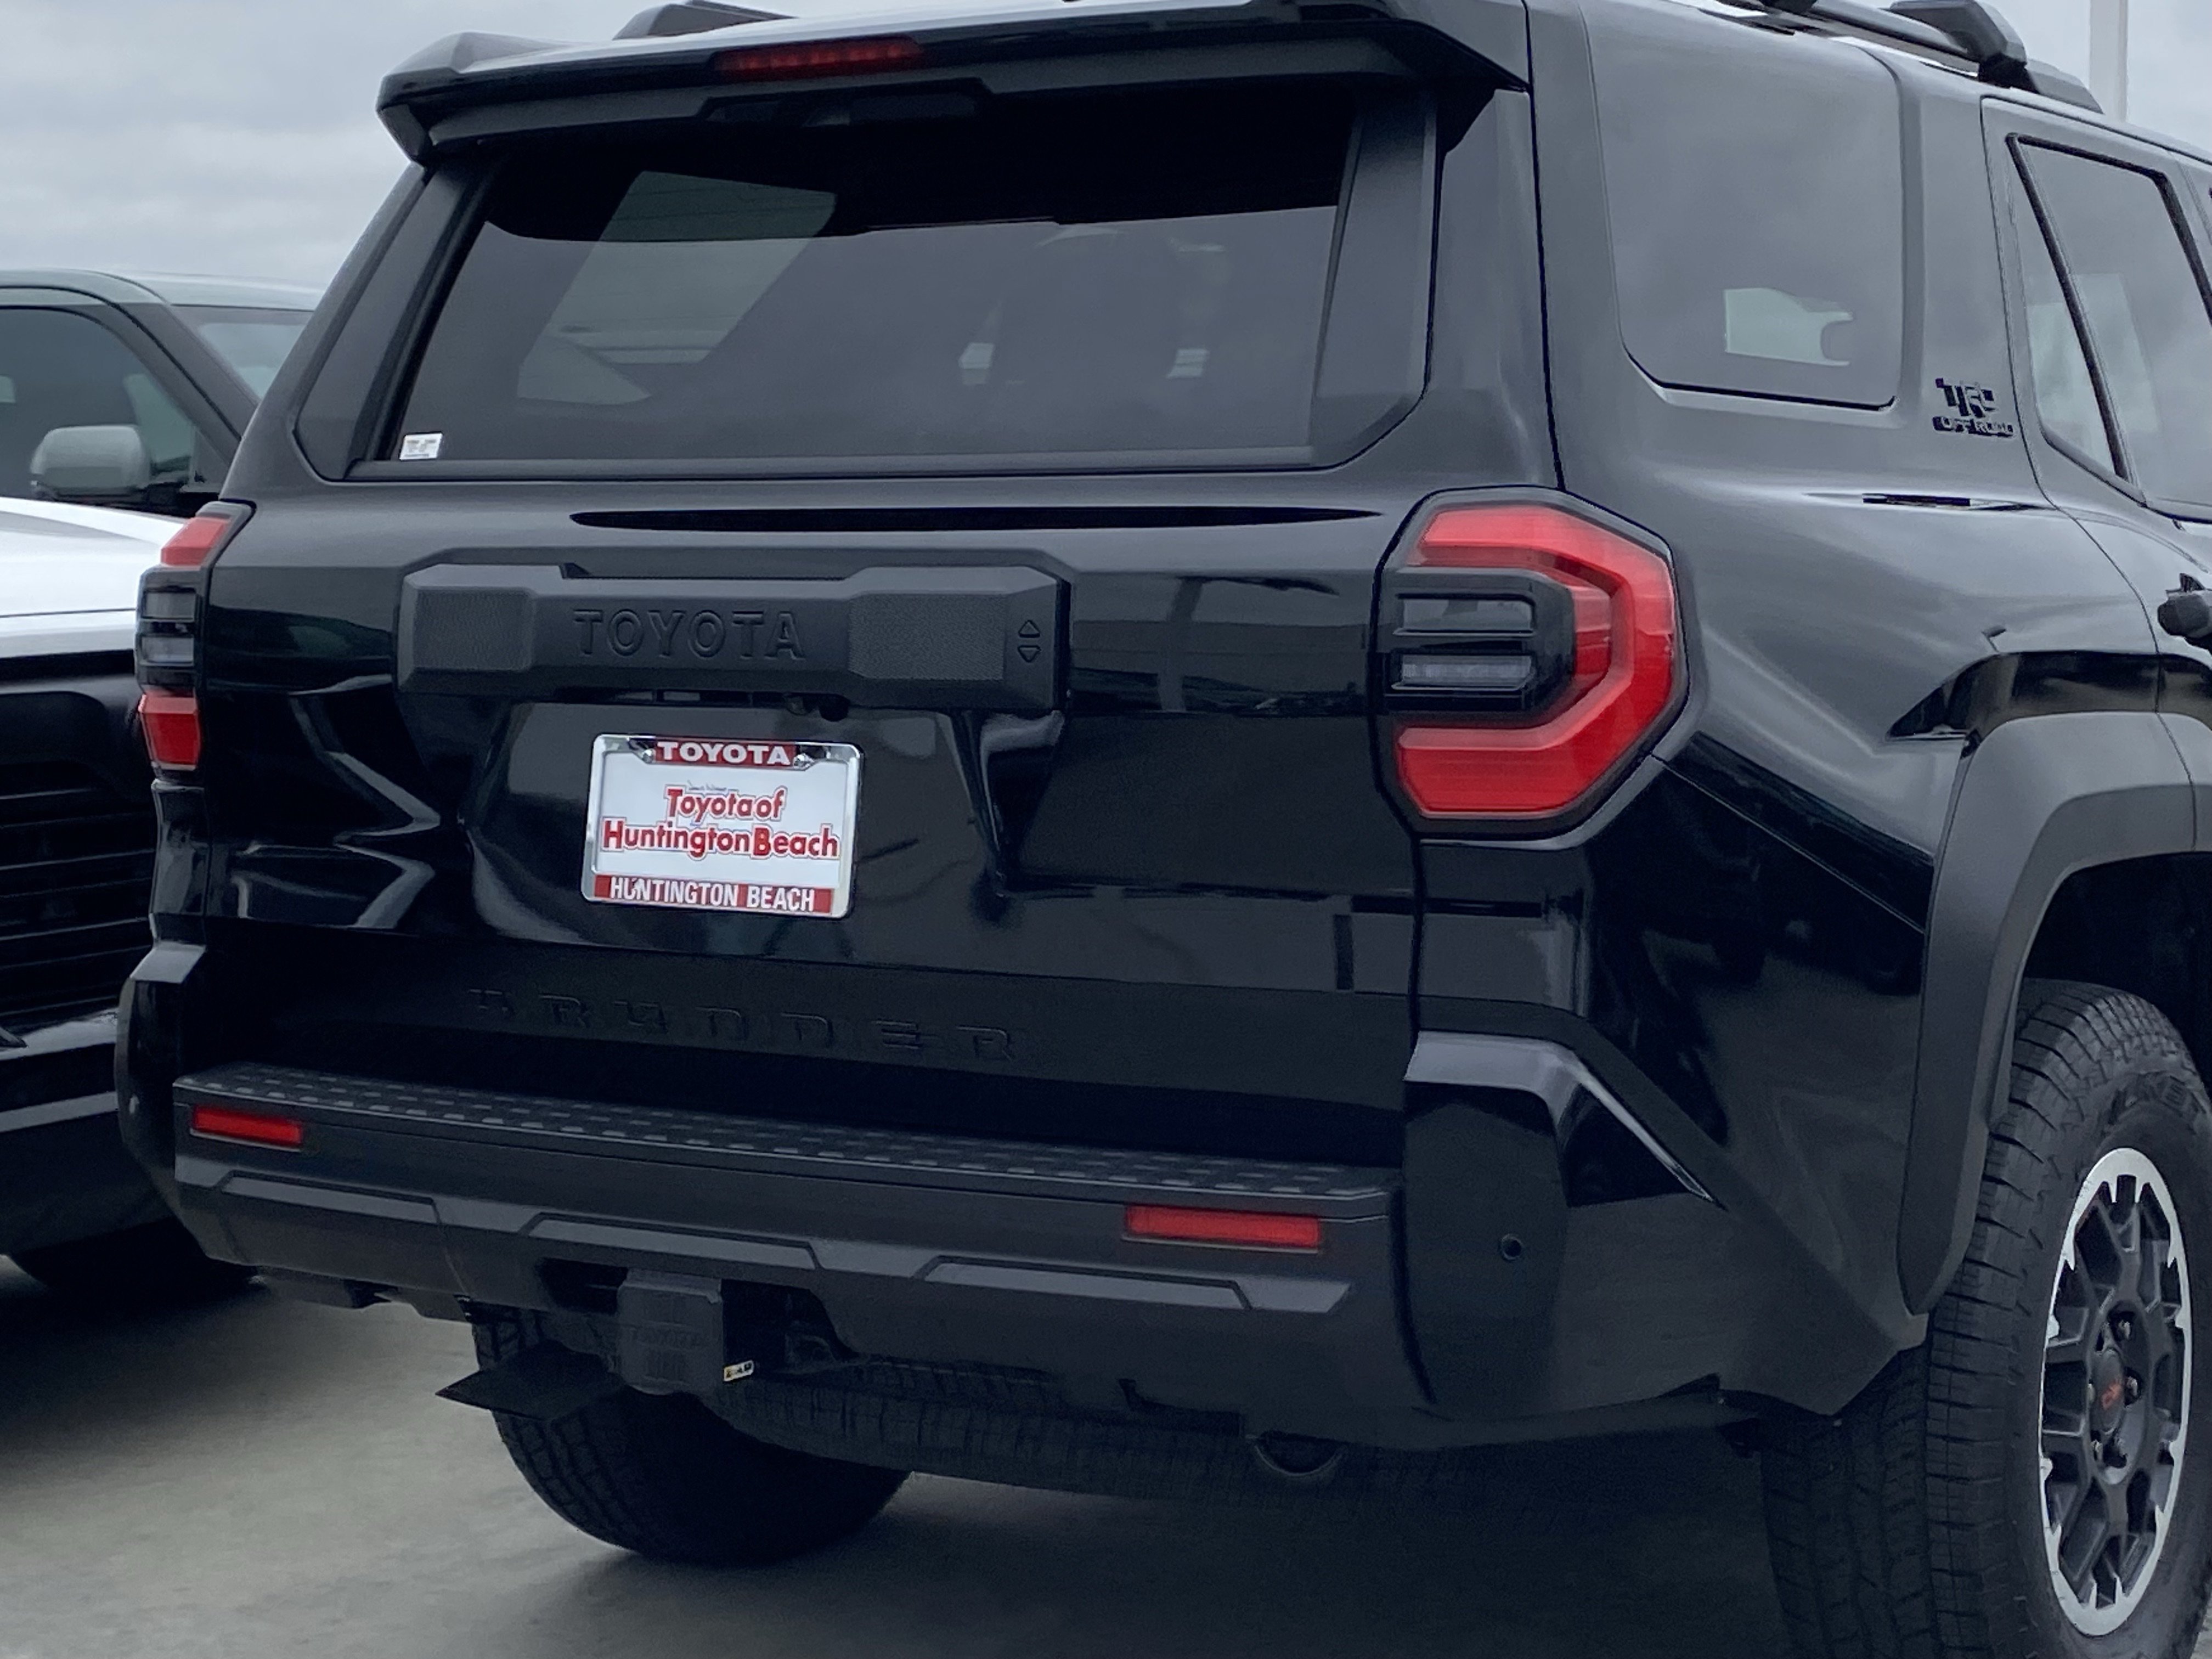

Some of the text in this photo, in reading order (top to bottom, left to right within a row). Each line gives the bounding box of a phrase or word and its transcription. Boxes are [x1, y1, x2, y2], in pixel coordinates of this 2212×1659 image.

[572, 608, 805, 659] TOYOTA
[657, 741, 791, 766] TOYOTA
[665, 788, 786, 822] Toyota of
[602, 821, 839, 858] Huntington Beach
[610, 876, 815, 912] HUNTINGTON BEACH
